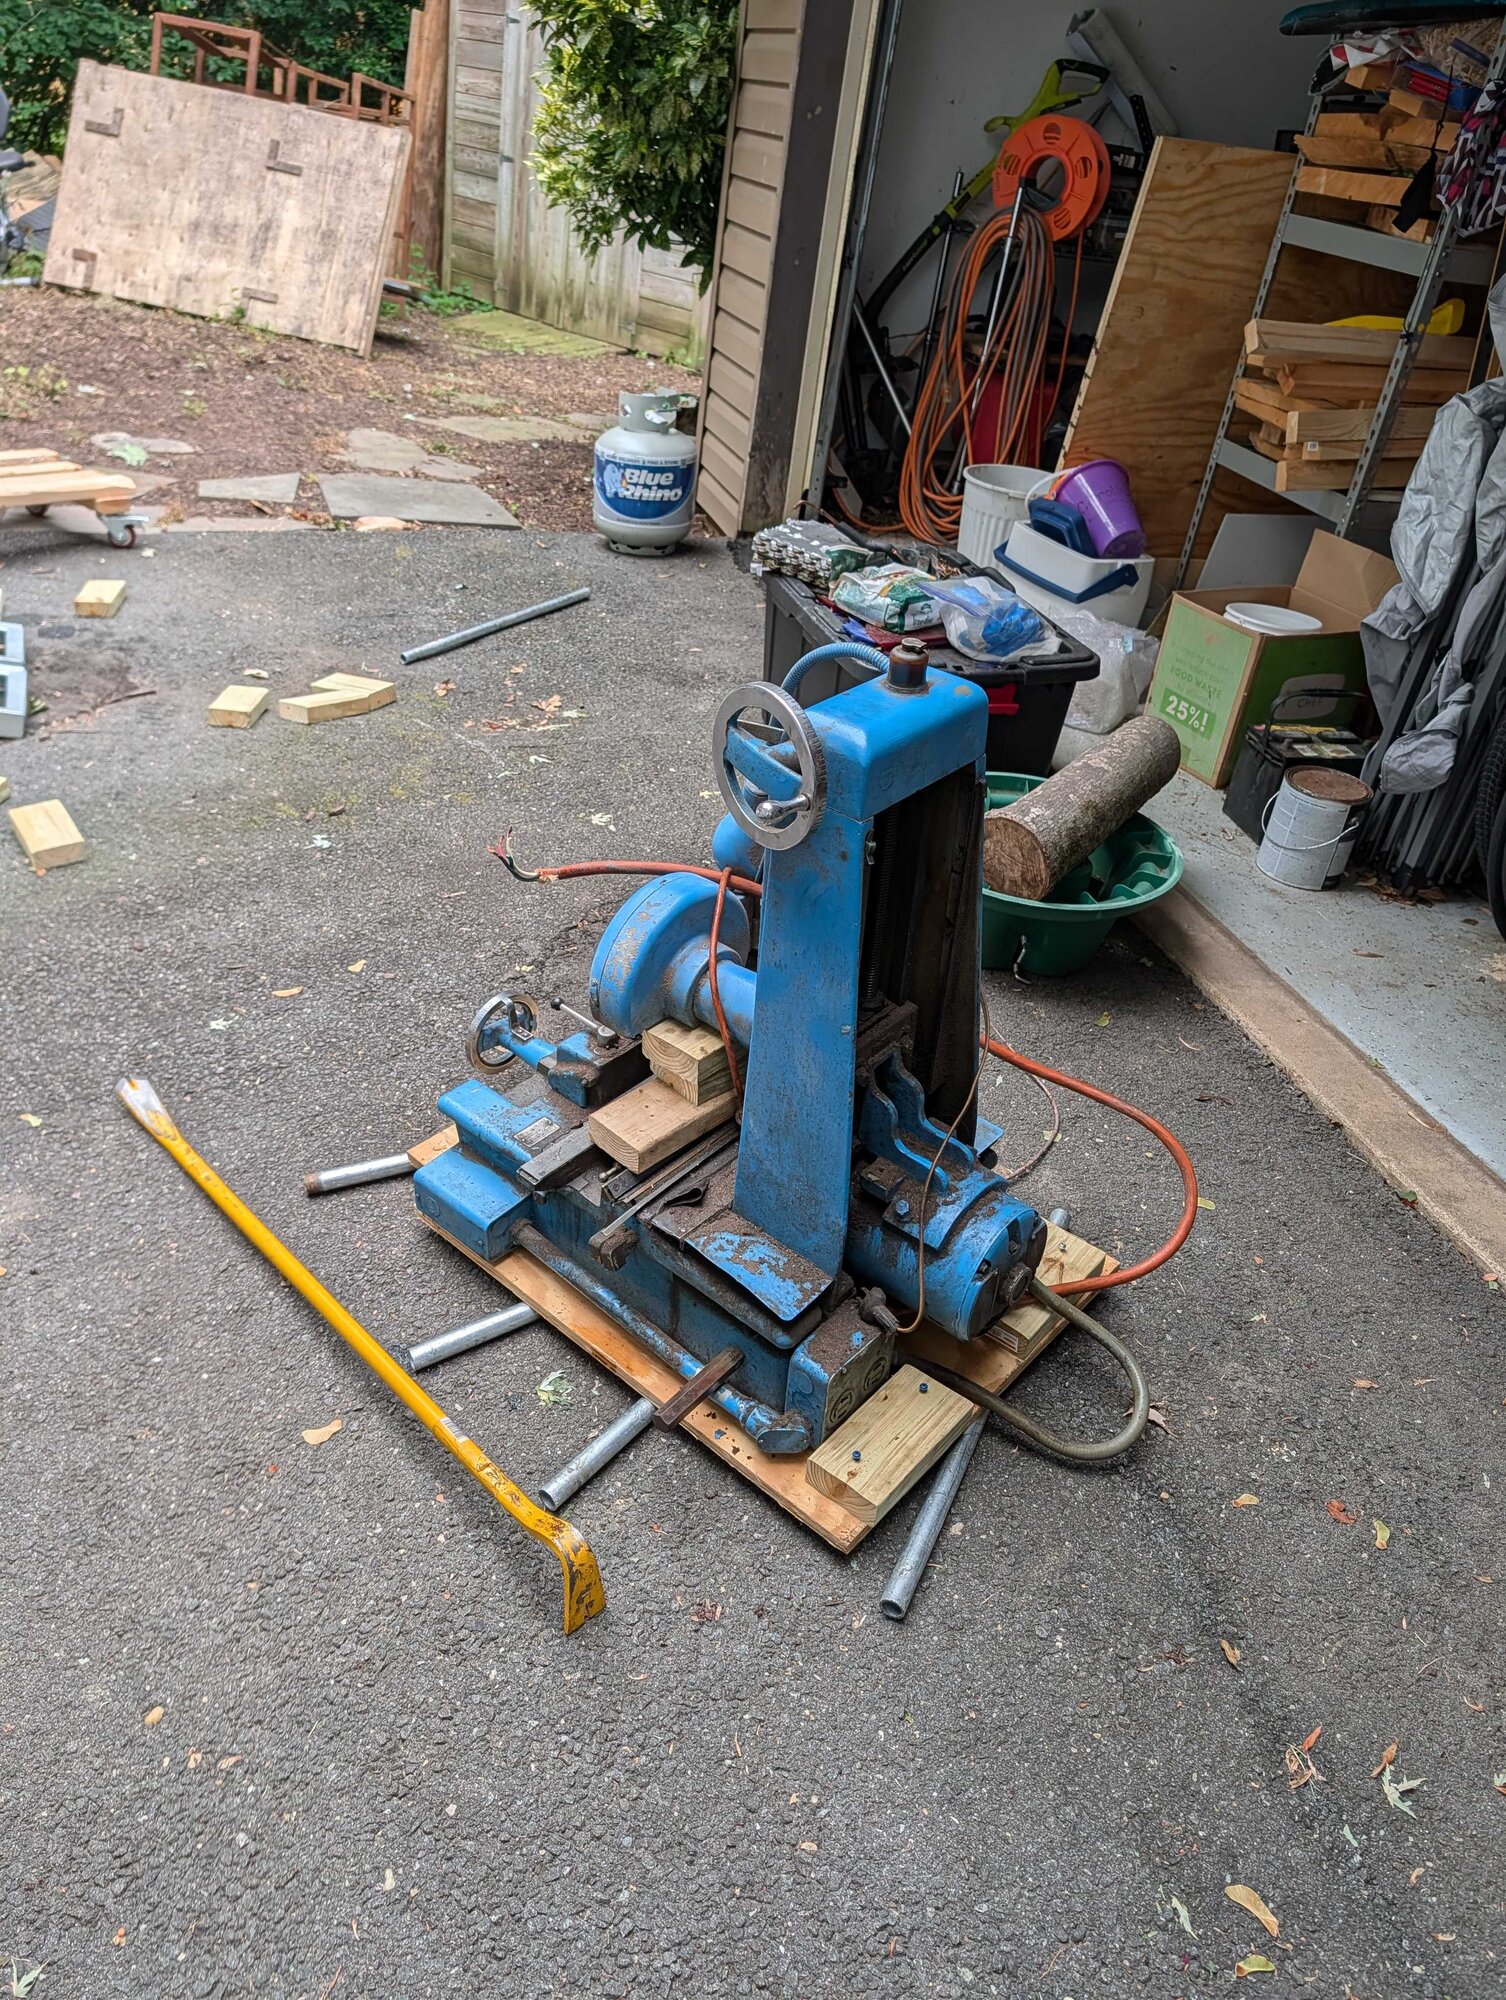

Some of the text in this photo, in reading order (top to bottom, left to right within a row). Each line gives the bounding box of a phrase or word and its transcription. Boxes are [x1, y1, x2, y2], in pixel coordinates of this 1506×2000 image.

[624, 468, 674, 486] Blue
[618, 485, 682, 501] Rhino
[1170, 665, 1193, 682] FOOD
[1194, 678, 1222, 698] WASTE
[1166, 695, 1209, 732] 25%!
